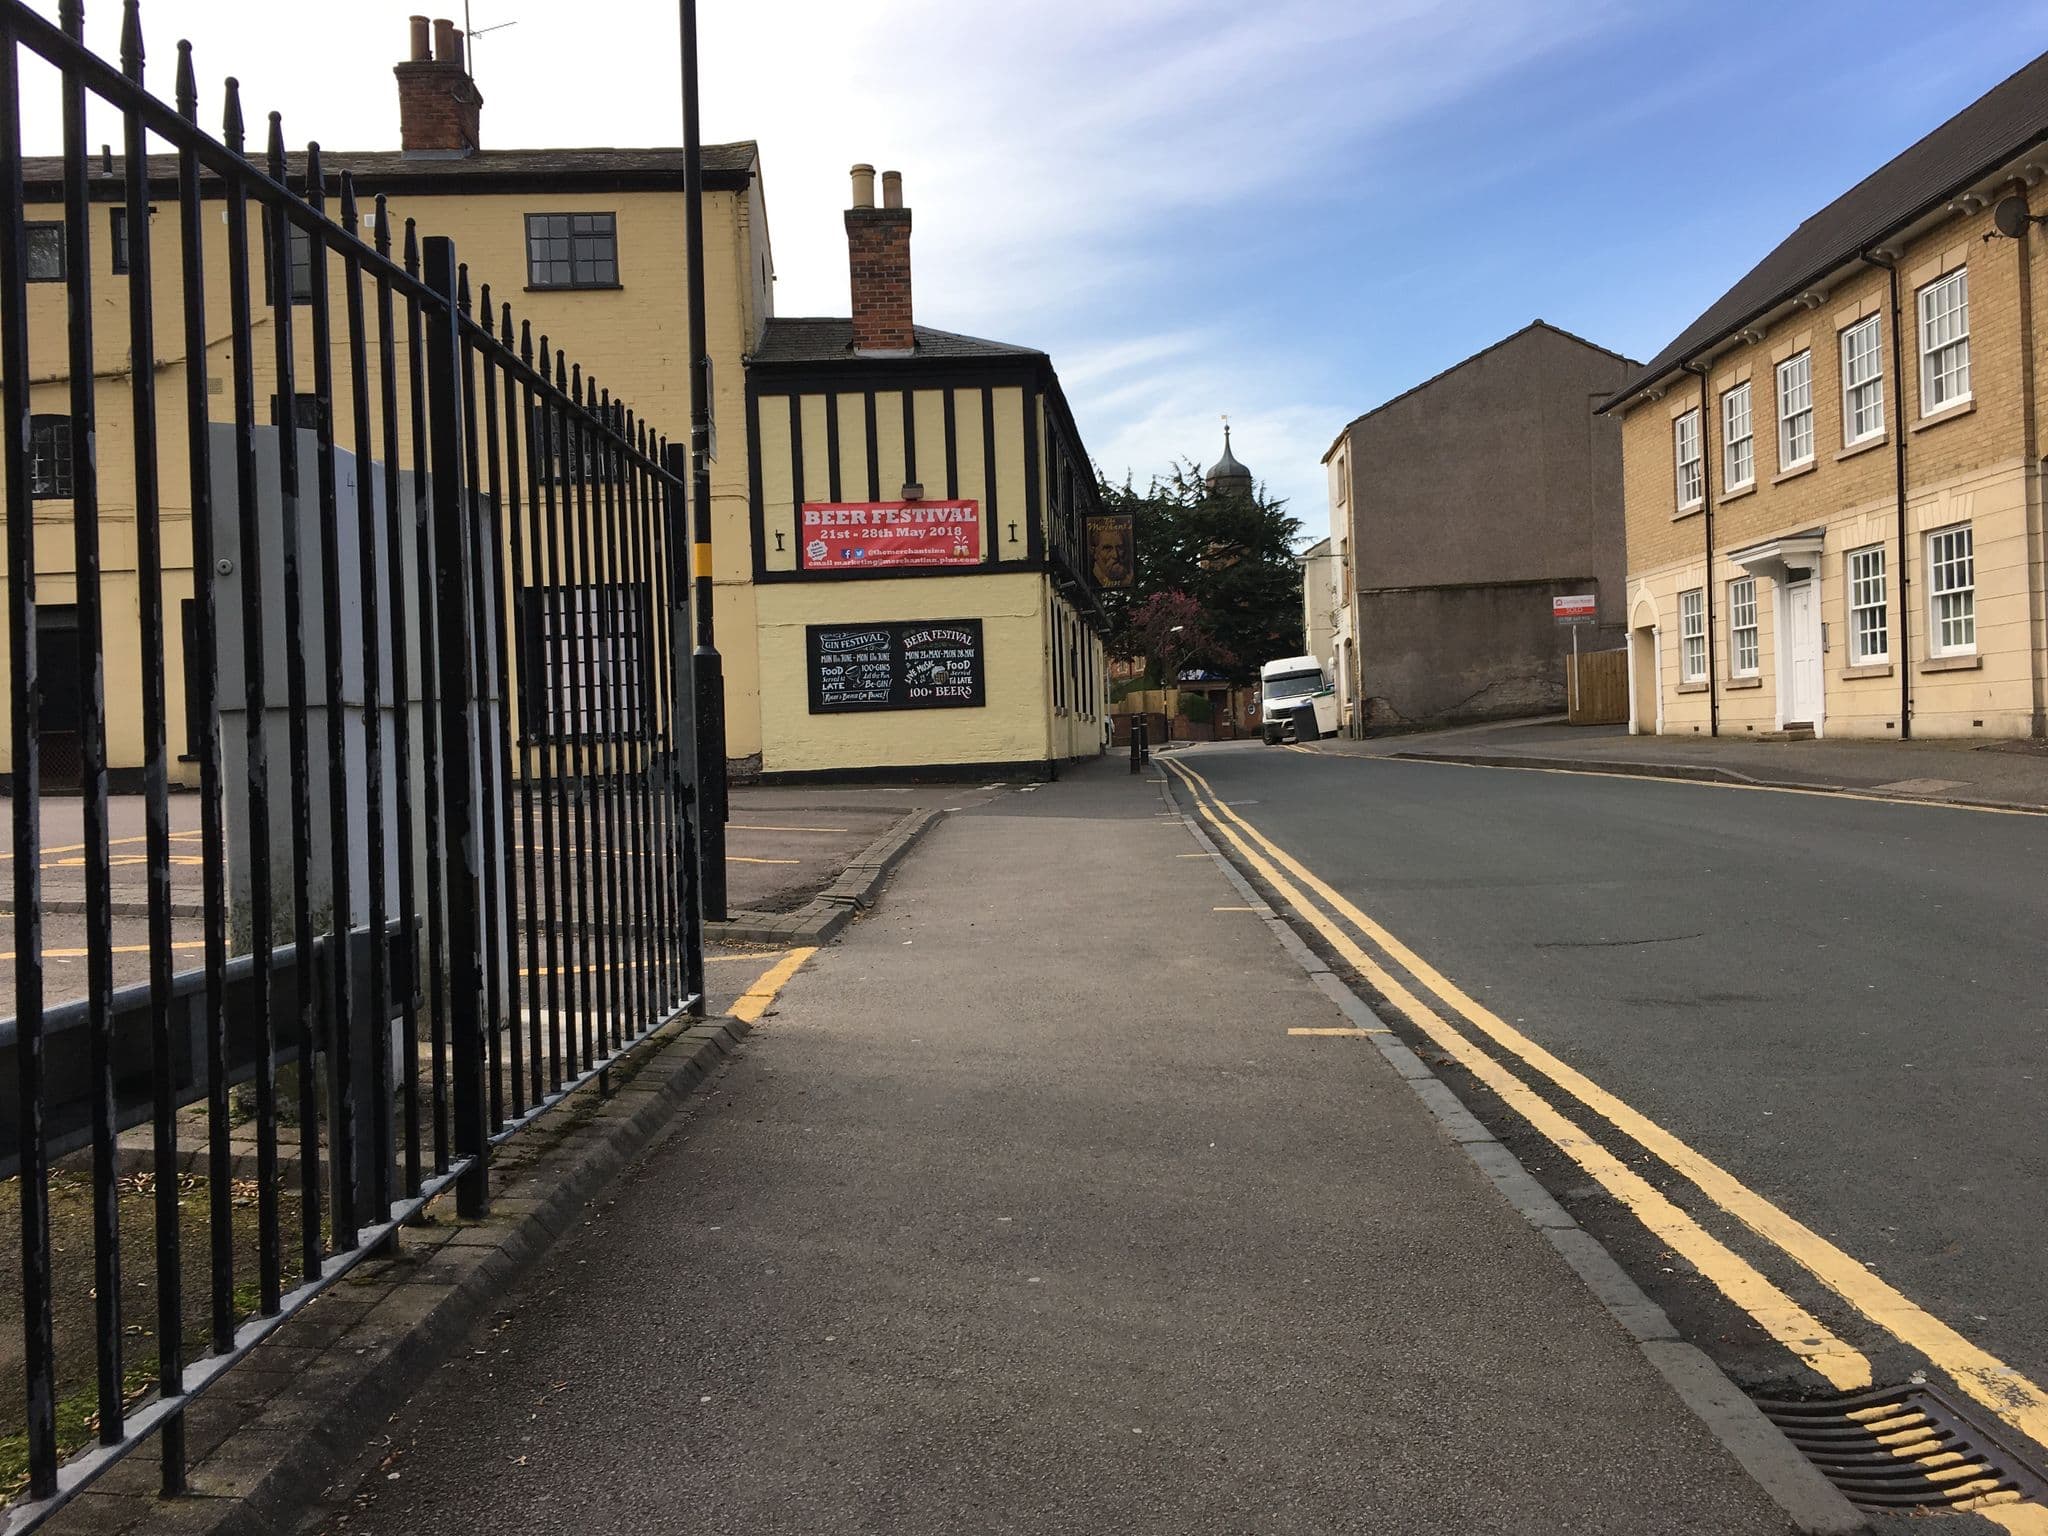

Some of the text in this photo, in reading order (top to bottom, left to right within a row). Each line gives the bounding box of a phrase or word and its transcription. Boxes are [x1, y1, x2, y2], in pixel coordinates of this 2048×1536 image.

[804, 507, 977, 525] BEER FESTIVAL
[820, 529, 850, 539] 21st
[862, 528, 893, 538] 28th
[896, 527, 926, 539] May
[929, 526, 962, 537] 2018
[808, 559, 833, 567] email
[825, 633, 884, 649] GIN FESTIVAL
[904, 629, 972, 648] BEER FESTIVAL
[904, 660, 935, 684] LIVE MUSIC
[822, 682, 846, 690] LATE
[957, 676, 973, 684] LATE
[935, 685, 972, 699] BEERS
